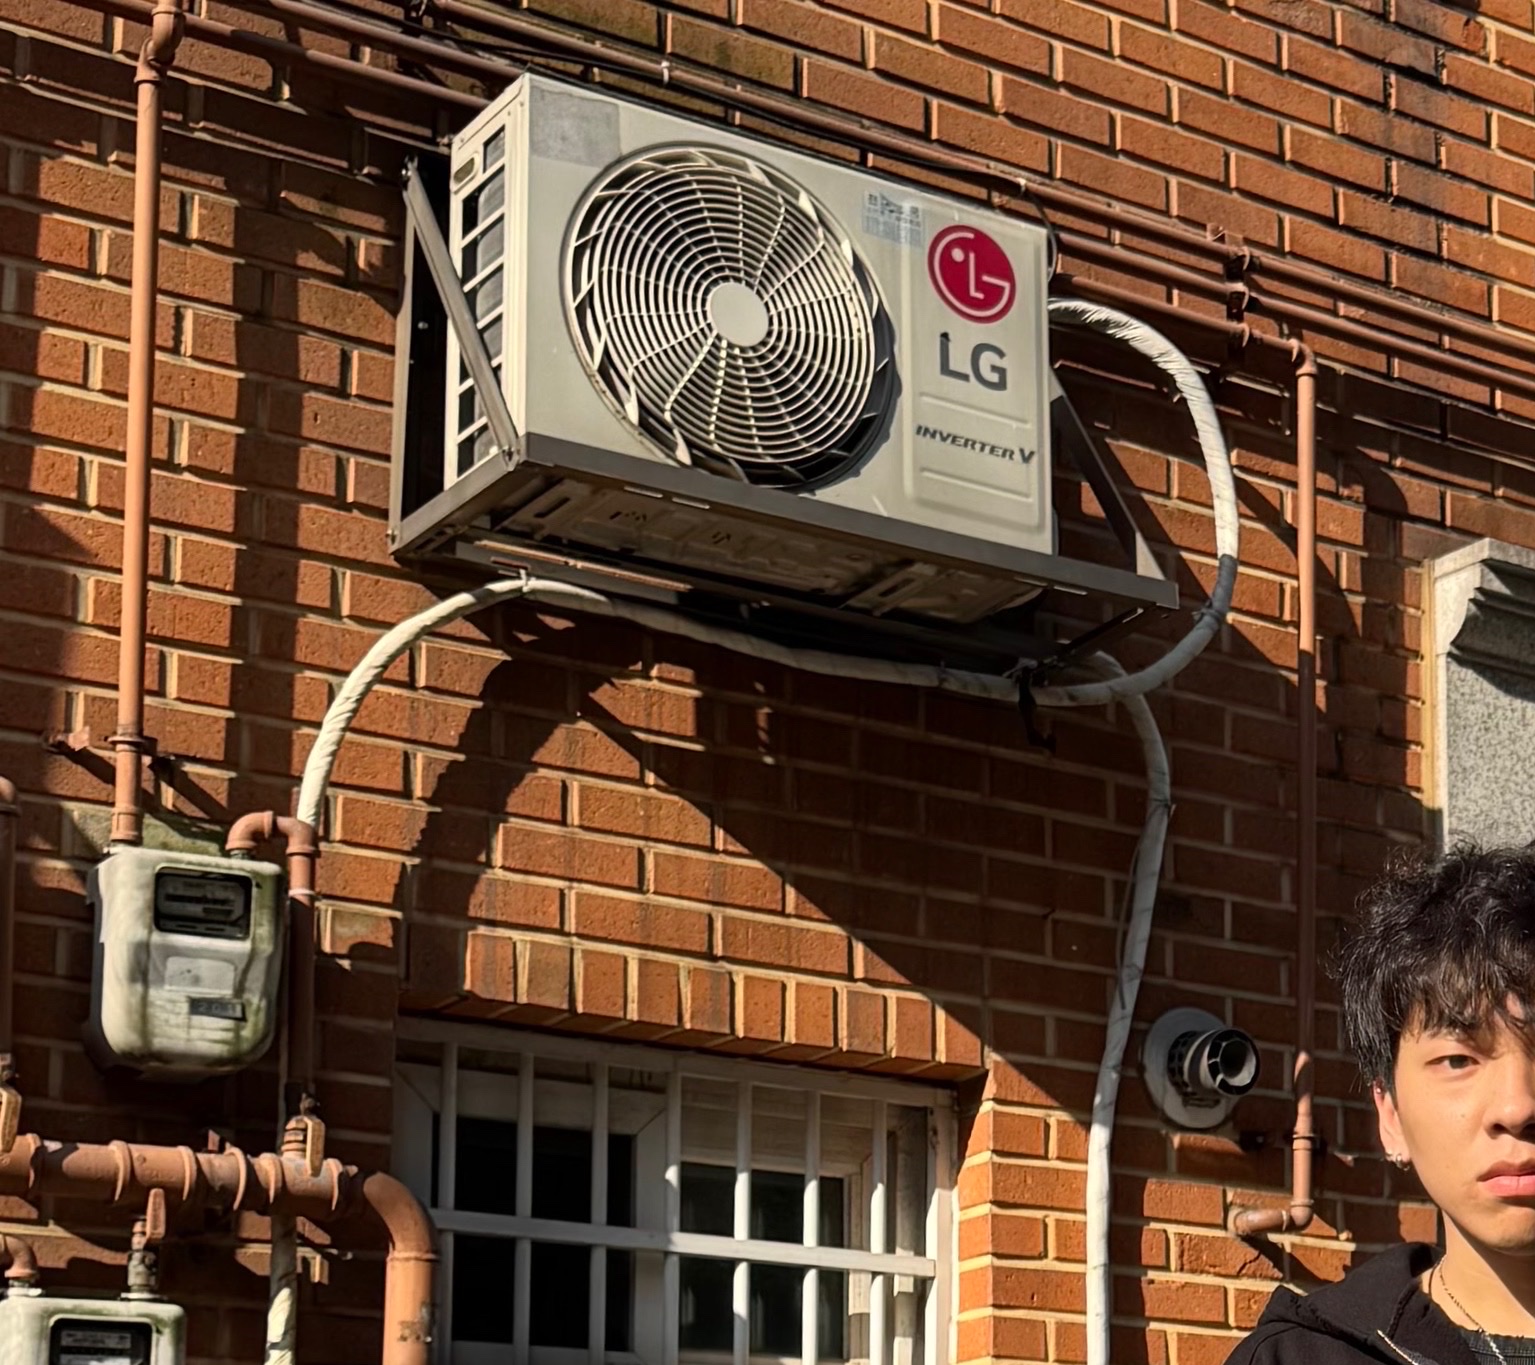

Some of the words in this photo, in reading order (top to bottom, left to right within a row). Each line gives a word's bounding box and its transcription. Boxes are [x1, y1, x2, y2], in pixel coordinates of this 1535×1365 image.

[939, 332, 1007, 391] LG
[916, 425, 1015, 461] INVERTER
[1018, 447, 1036, 464] V
